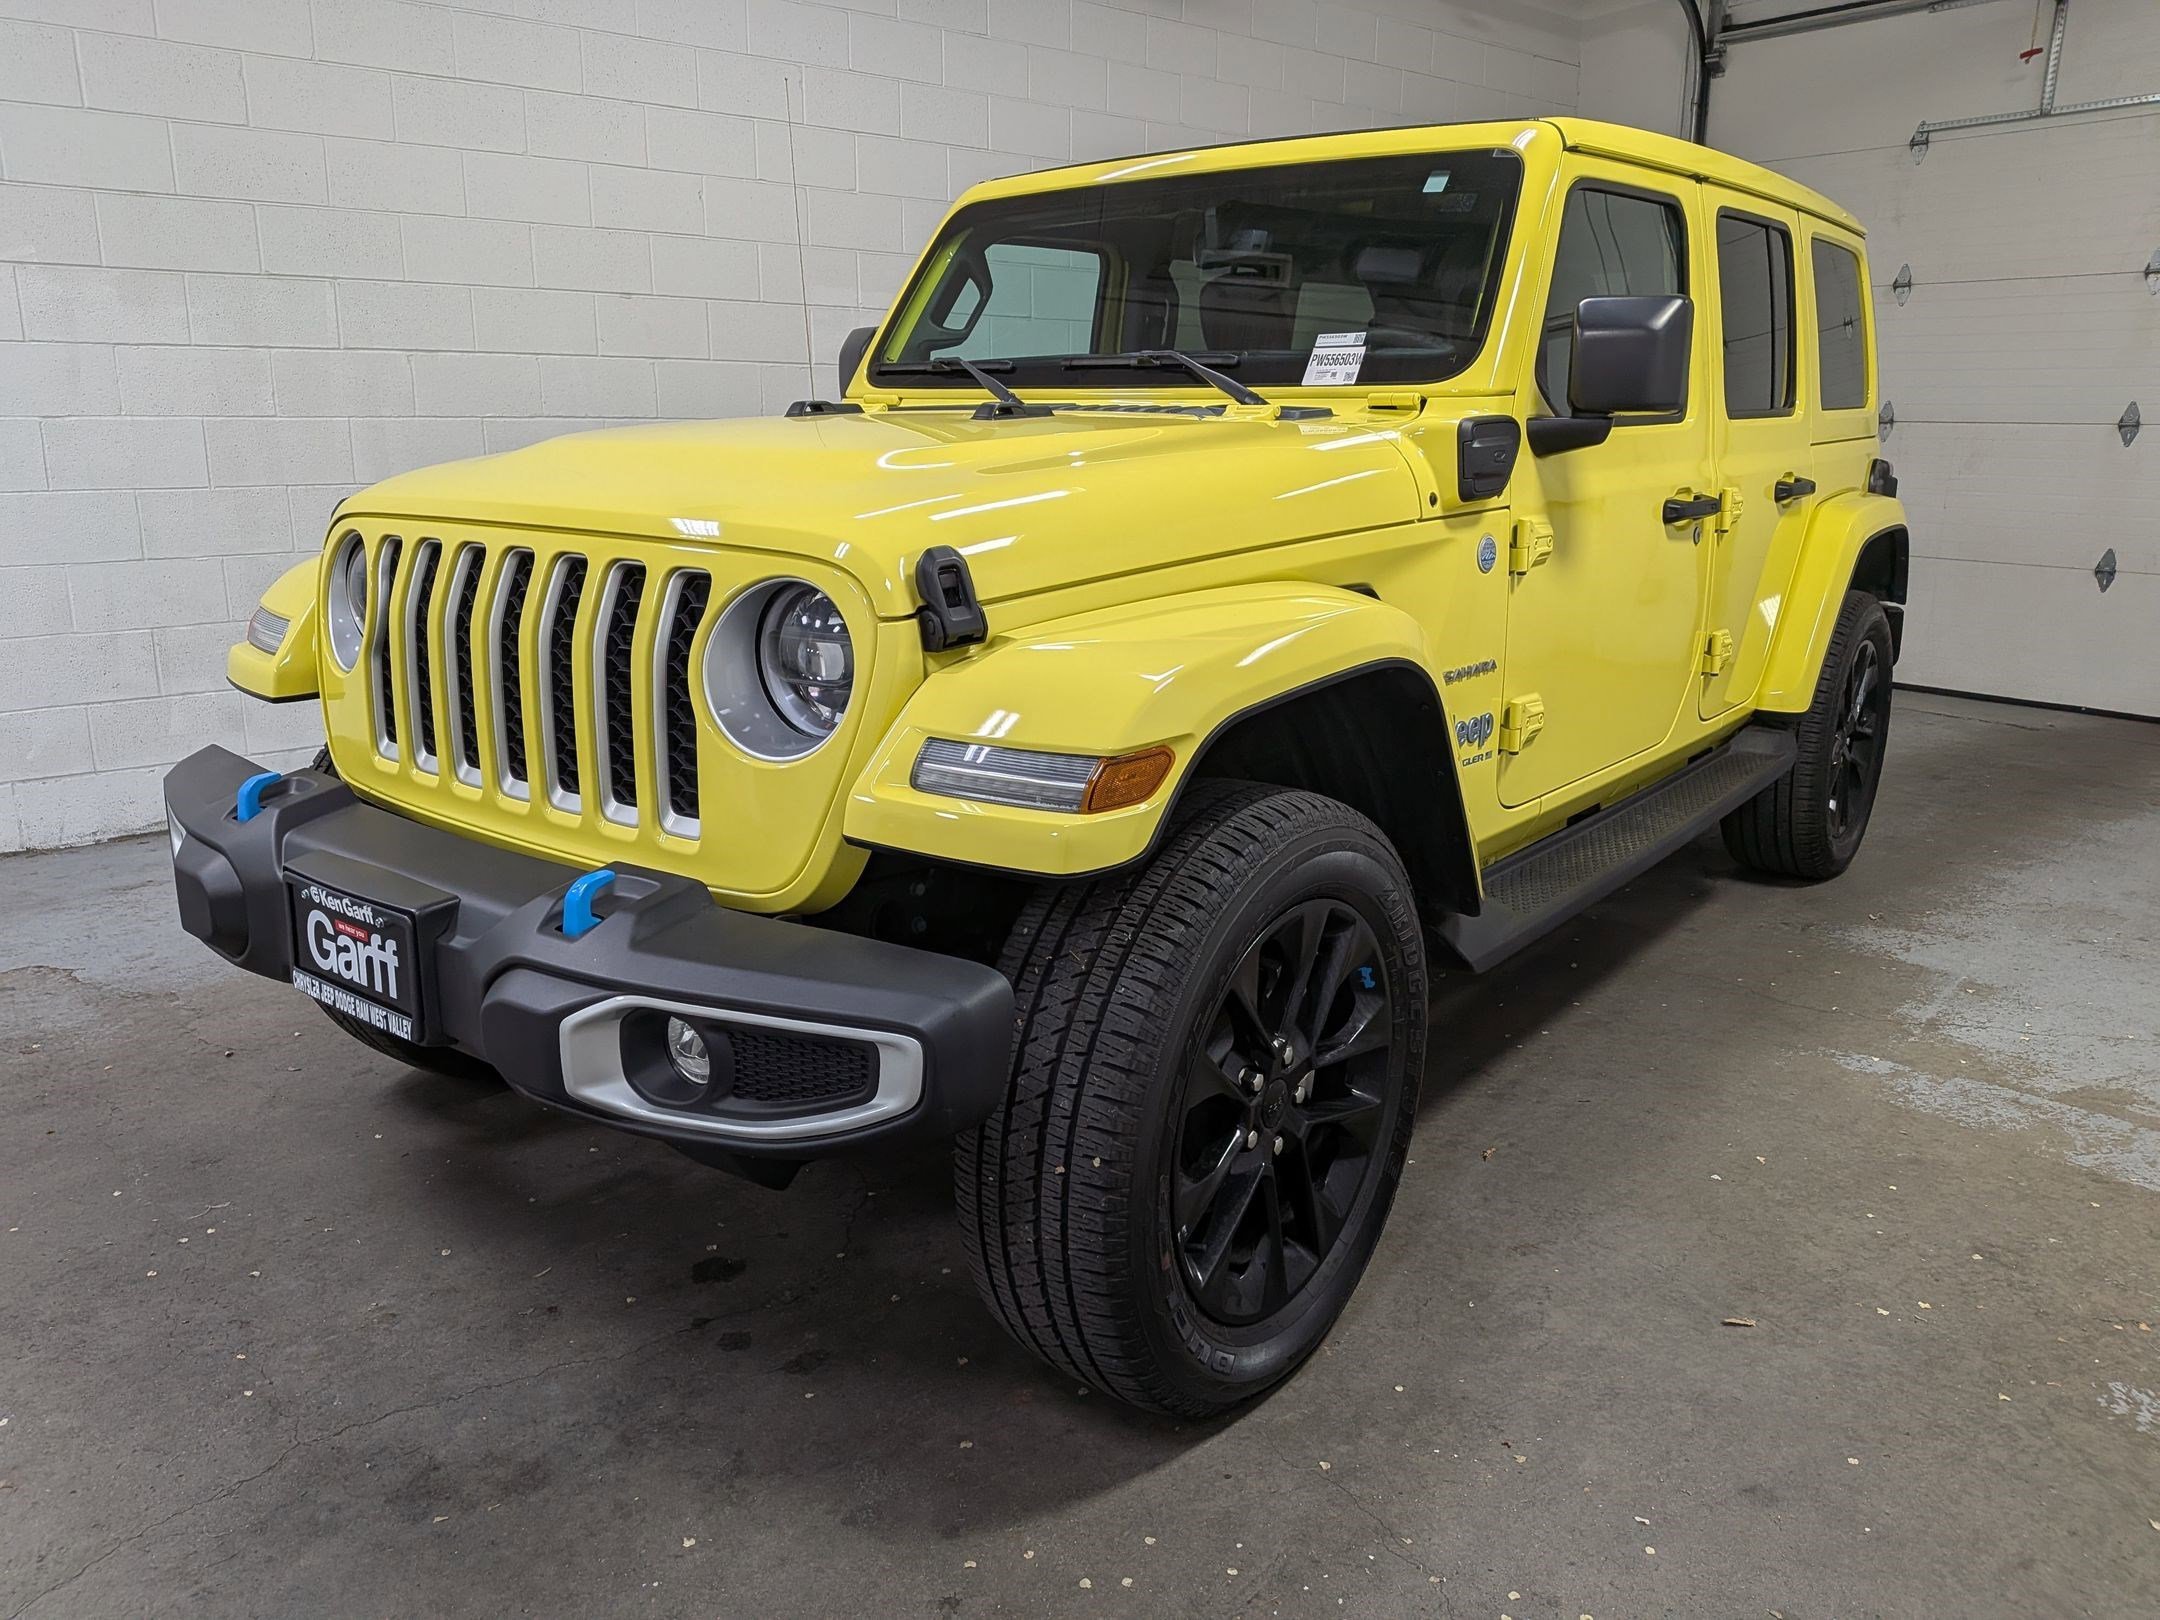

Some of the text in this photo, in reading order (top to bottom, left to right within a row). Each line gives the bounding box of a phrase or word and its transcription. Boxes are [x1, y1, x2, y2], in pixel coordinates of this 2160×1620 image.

[1443, 659, 1497, 686] SAHARA
[1453, 712, 1494, 750] eep
[307, 909, 399, 1000] Garff
[293, 970, 412, 1040] CHRYSLER JEEP DODGE RAM WEST VALLEY
